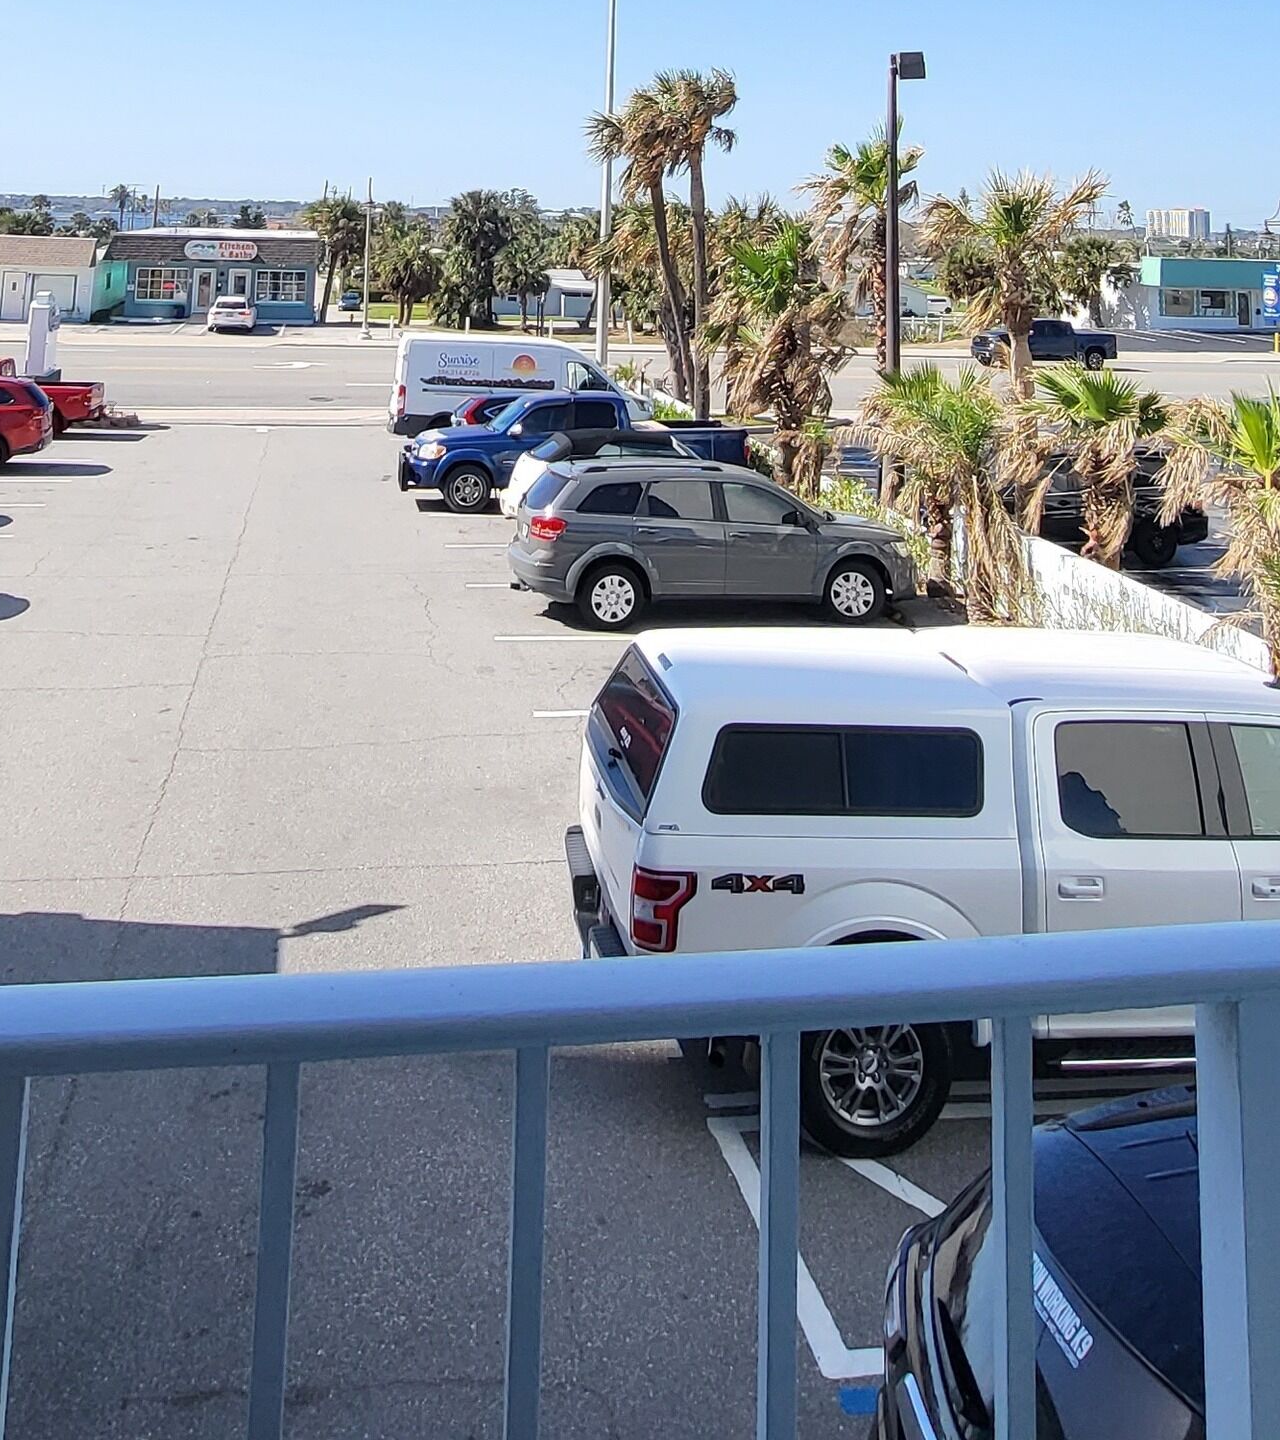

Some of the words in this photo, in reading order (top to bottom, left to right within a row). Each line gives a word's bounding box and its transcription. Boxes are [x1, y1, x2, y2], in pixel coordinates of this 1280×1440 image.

[218, 242, 255, 250] Kitchens
[438, 352, 480, 368] Sunrise
[1037, 1273, 1081, 1341] WORKING
[1070, 1325, 1094, 1360] K9
